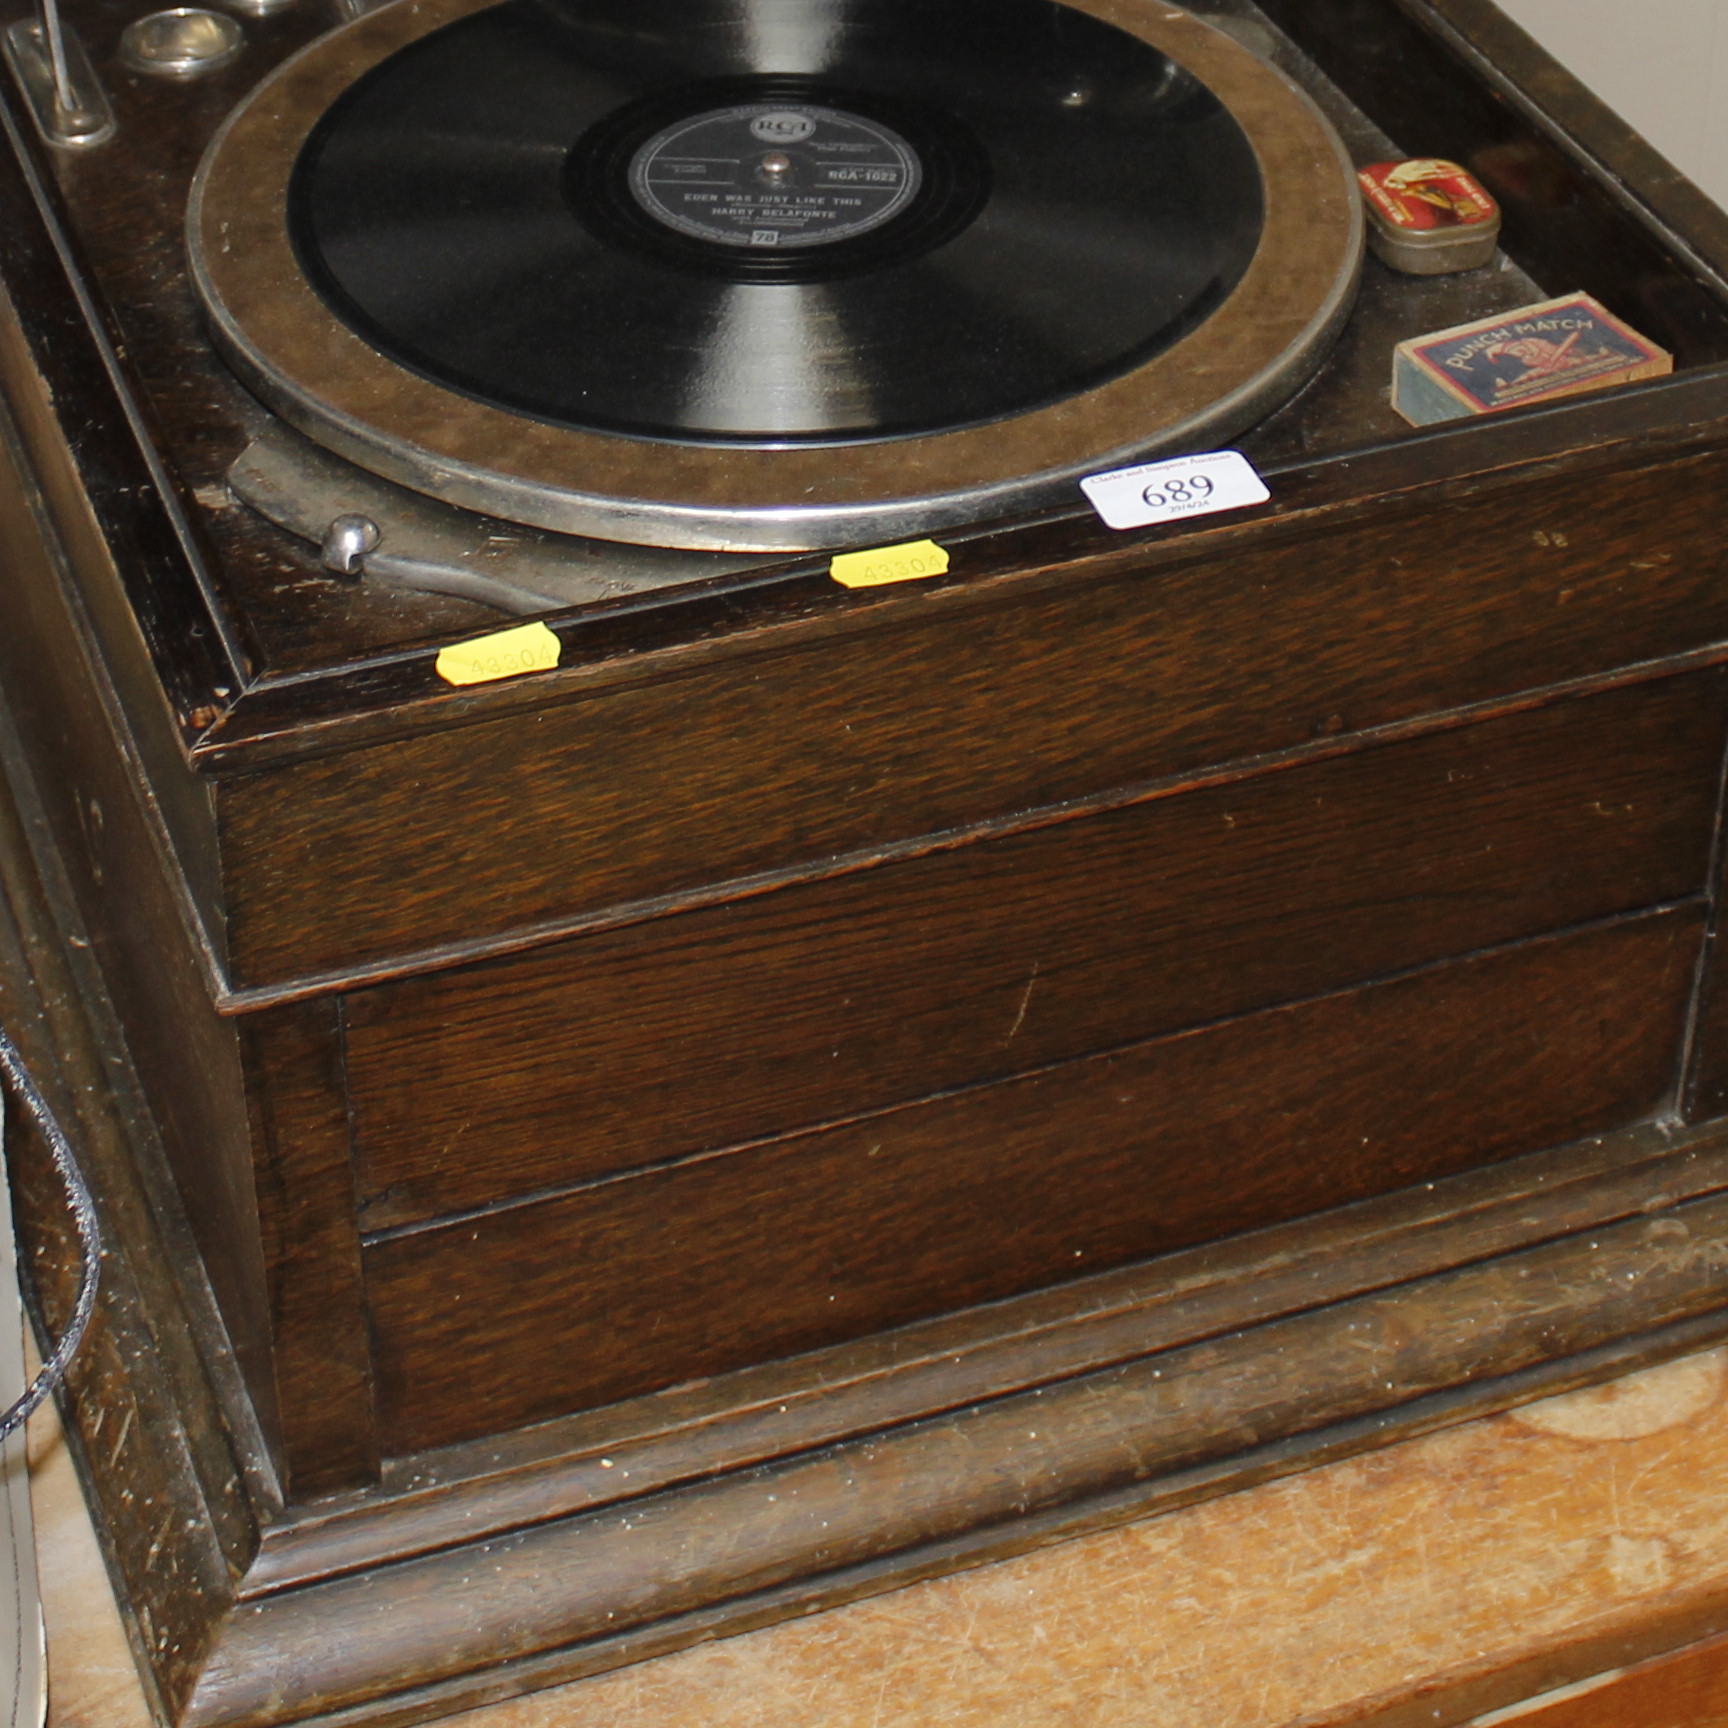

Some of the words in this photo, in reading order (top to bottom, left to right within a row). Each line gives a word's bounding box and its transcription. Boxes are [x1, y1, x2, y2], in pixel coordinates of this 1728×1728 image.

[684, 193, 718, 202] EDEN
[725, 194, 752, 203] WAS
[759, 195, 789, 204] JUST
[796, 196, 825, 205] LIKE
[833, 197, 862, 206] THIS
[712, 207, 755, 216] HARRY
[762, 209, 837, 219] BELAFONTE
[755, 232, 776, 243] 78
[1445, 328, 1513, 371] PUNCH
[1516, 319, 1594, 335] MATCH
[1090, 471, 1122, 485] Clarke
[1126, 467, 1143, 478] and
[1146, 461, 1187, 475] Simpson
[1189, 453, 1232, 466] Auctions
[1141, 475, 1215, 507] 689
[863, 555, 944, 581] 43304
[470, 644, 553, 676] 43304
